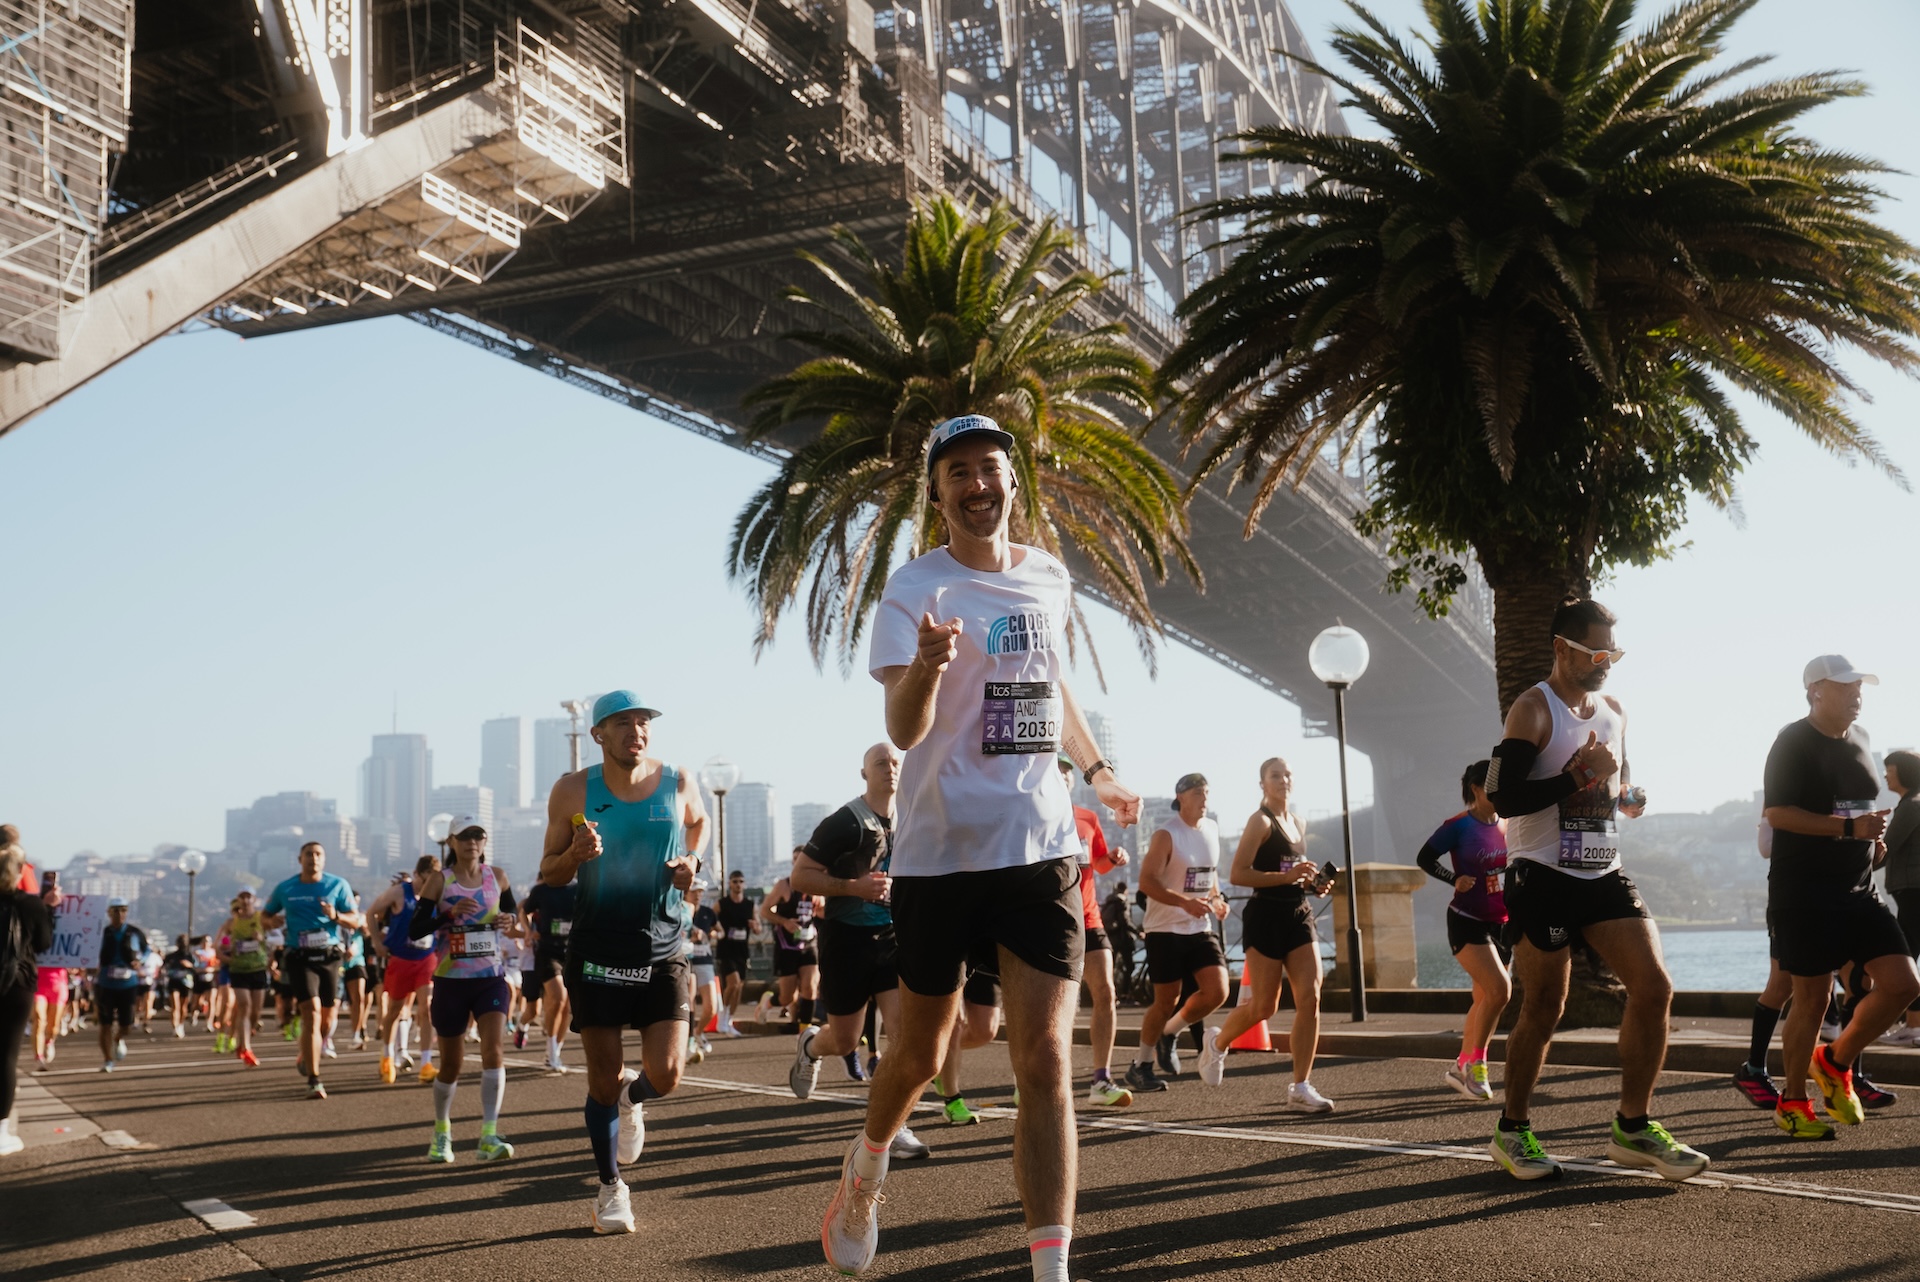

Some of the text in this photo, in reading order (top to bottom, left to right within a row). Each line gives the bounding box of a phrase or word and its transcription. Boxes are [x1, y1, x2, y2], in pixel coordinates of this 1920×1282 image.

[956, 422, 971, 431] RUN
[1009, 613, 1050, 633] COOGE
[1002, 633, 1028, 653] RUN
[993, 684, 1010, 697] tcs
[1015, 700, 1037, 717] ANDY
[987, 725, 996, 738] 2
[1001, 725, 1012, 738] A
[1564, 821, 1578, 830] tcs
[1562, 848, 1569, 858] 2
[1572, 849, 1580, 858] A
[1584, 847, 1617, 859] 20028
[469, 941, 492, 951] 16519
[586, 963, 593, 972] 2
